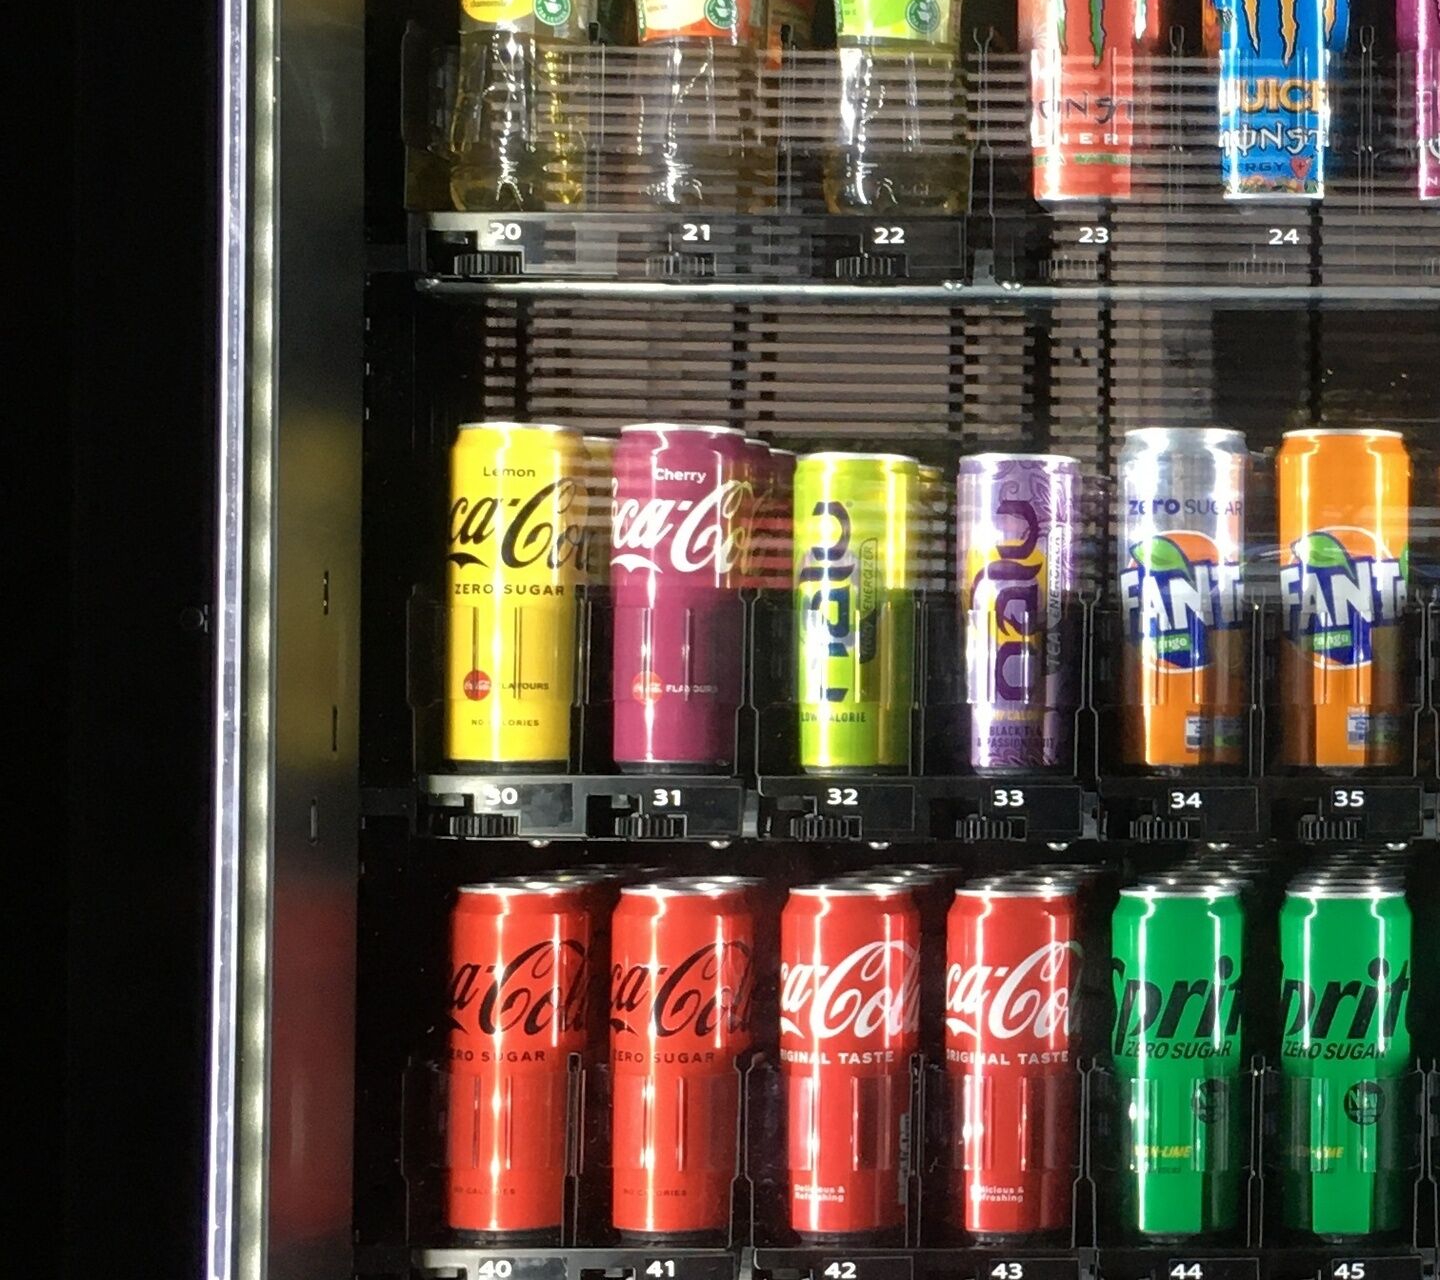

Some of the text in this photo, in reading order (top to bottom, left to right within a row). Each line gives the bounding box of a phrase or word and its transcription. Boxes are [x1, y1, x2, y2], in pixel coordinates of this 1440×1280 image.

[489, 223, 521, 241] 20
[682, 223, 711, 241] 21
[873, 226, 905, 245] 22
[1078, 226, 1109, 244] 23
[1268, 228, 1300, 245] 24
[483, 465, 536, 478] Lemon
[655, 467, 707, 484] Cherry
[454, 582, 565, 596] ZERO SUGAR
[486, 788, 518, 805] 30
[652, 788, 681, 807] 31
[826, 787, 858, 806] 32
[993, 789, 1025, 807] 33
[1170, 792, 1203, 809] 34
[1334, 790, 1364, 807] 35
[653, 1051, 715, 1064] SUGAR
[838, 1050, 894, 1065] TASTE
[1017, 1049, 1069, 1065] TASTE
[1172, 1040, 1231, 1059] SUGAR
[1284, 1040, 1385, 1059] ZERO SUGAR
[478, 1261, 511, 1278] 40
[645, 1260, 675, 1278] 41
[824, 1261, 857, 1279] 42
[991, 1263, 1023, 1280] 43
[1170, 1263, 1203, 1280] 44
[1333, 1262, 1365, 1280] 45
